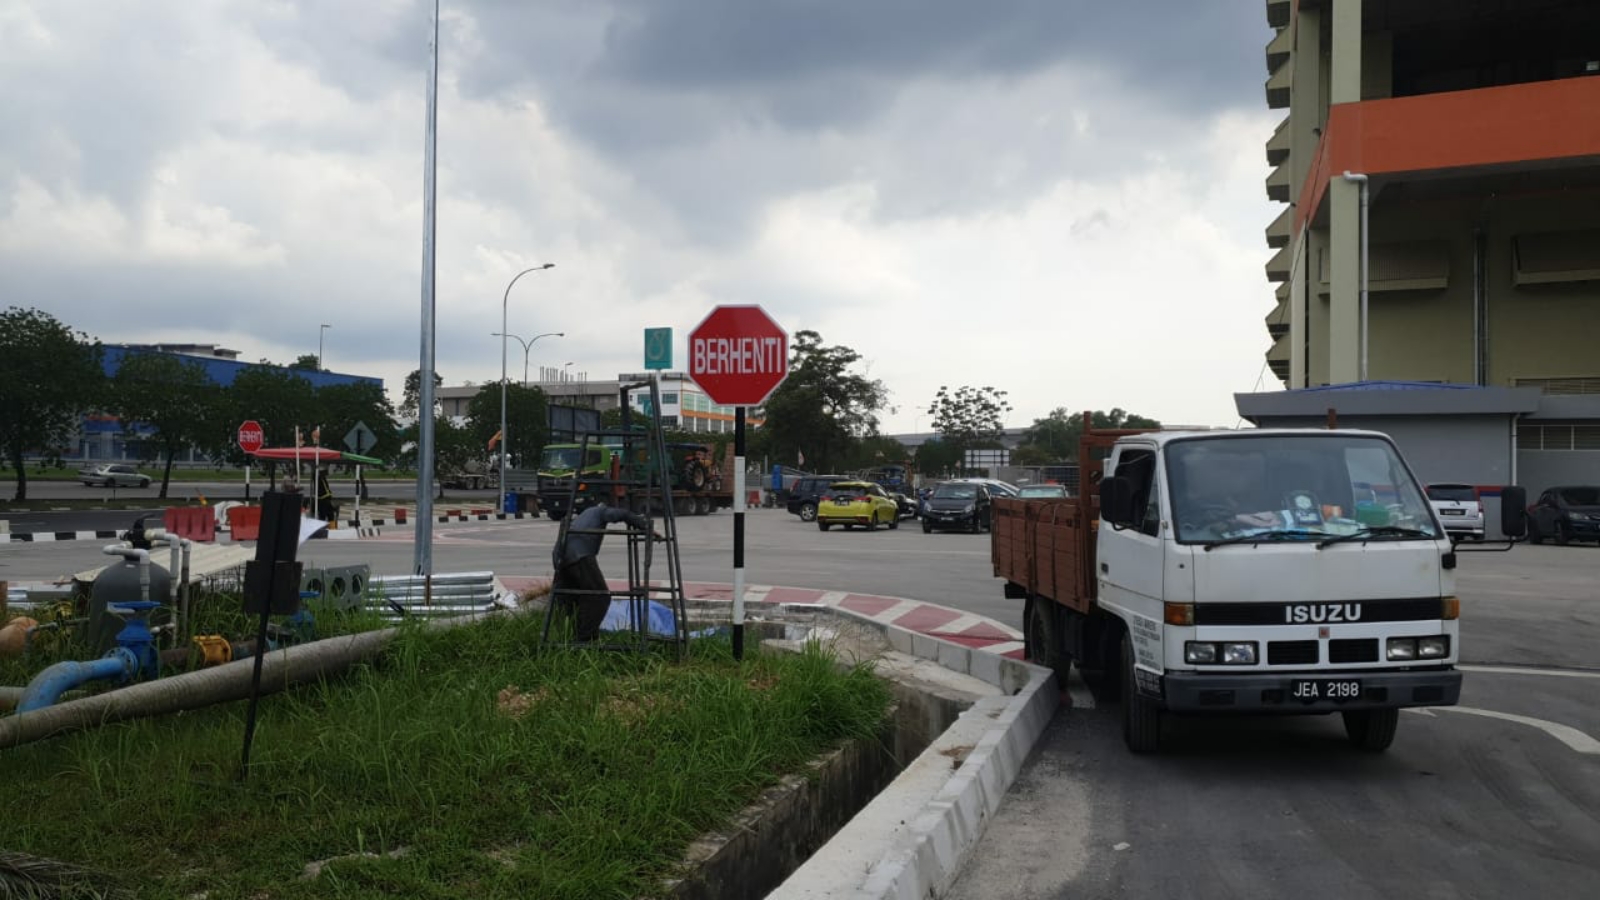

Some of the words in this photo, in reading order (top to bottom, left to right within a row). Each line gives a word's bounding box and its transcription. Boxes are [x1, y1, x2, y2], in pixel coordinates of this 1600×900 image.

[694, 337, 782, 374] BERHENTI
[1285, 603, 1362, 623] ISUZU
[1293, 682, 1319, 697] JEA
[1326, 682, 1360, 697] 2198
